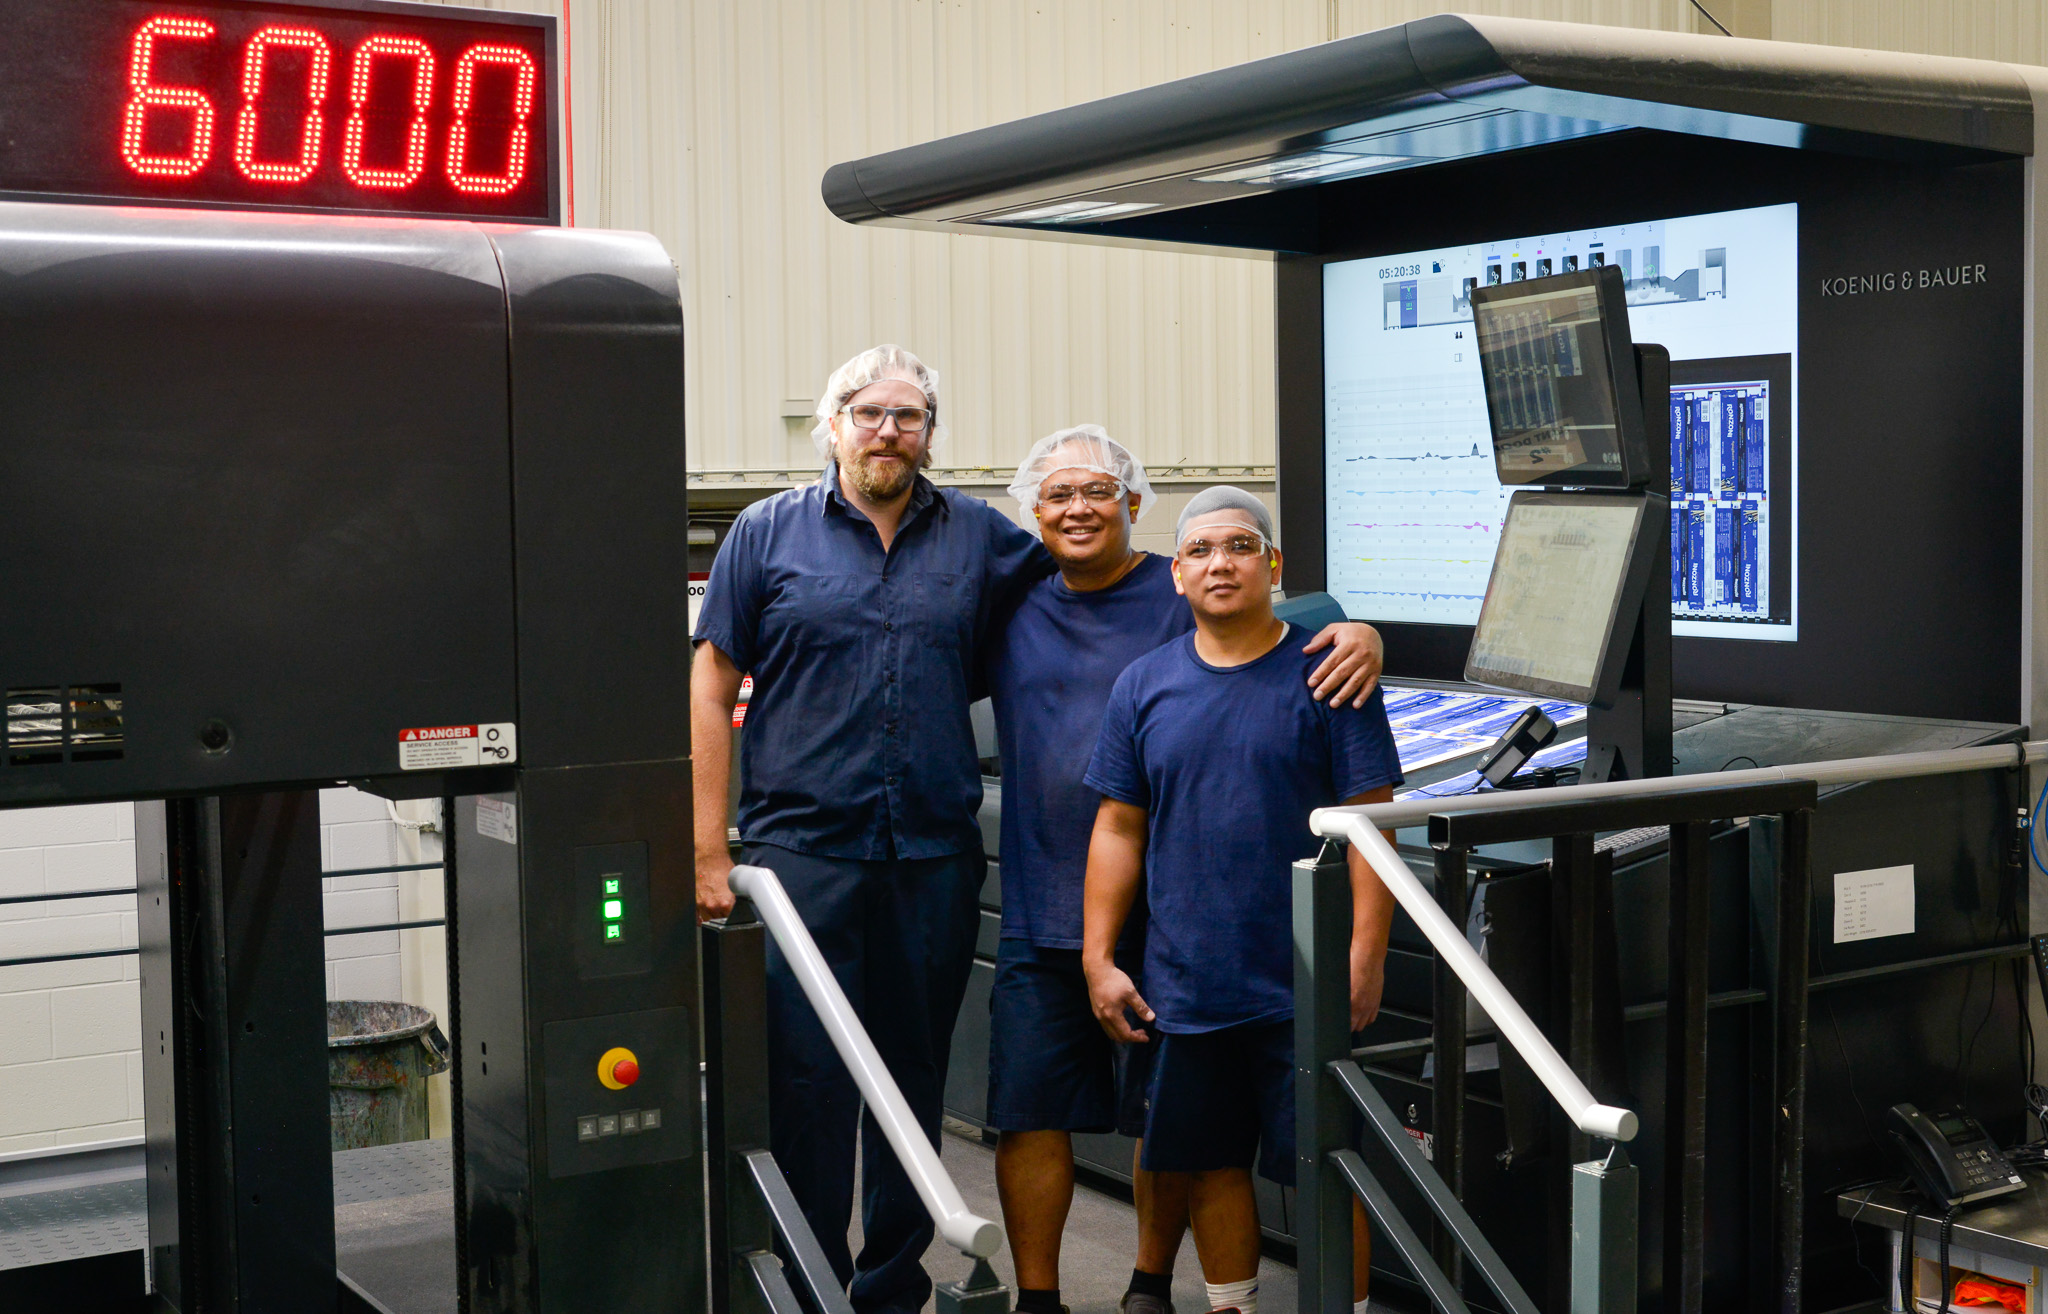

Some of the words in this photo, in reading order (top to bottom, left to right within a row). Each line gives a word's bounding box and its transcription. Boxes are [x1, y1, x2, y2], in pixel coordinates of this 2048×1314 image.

[122, 16, 535, 193] 6000
[1378, 264, 1421, 279] 05:20:38
[1822, 273, 1895, 296] KOENIG
[1901, 271, 1913, 290] &
[1919, 264, 1987, 288] BAUER
[419, 727, 471, 740] DANGER
[1404, 1128, 1420, 1138] NGER
